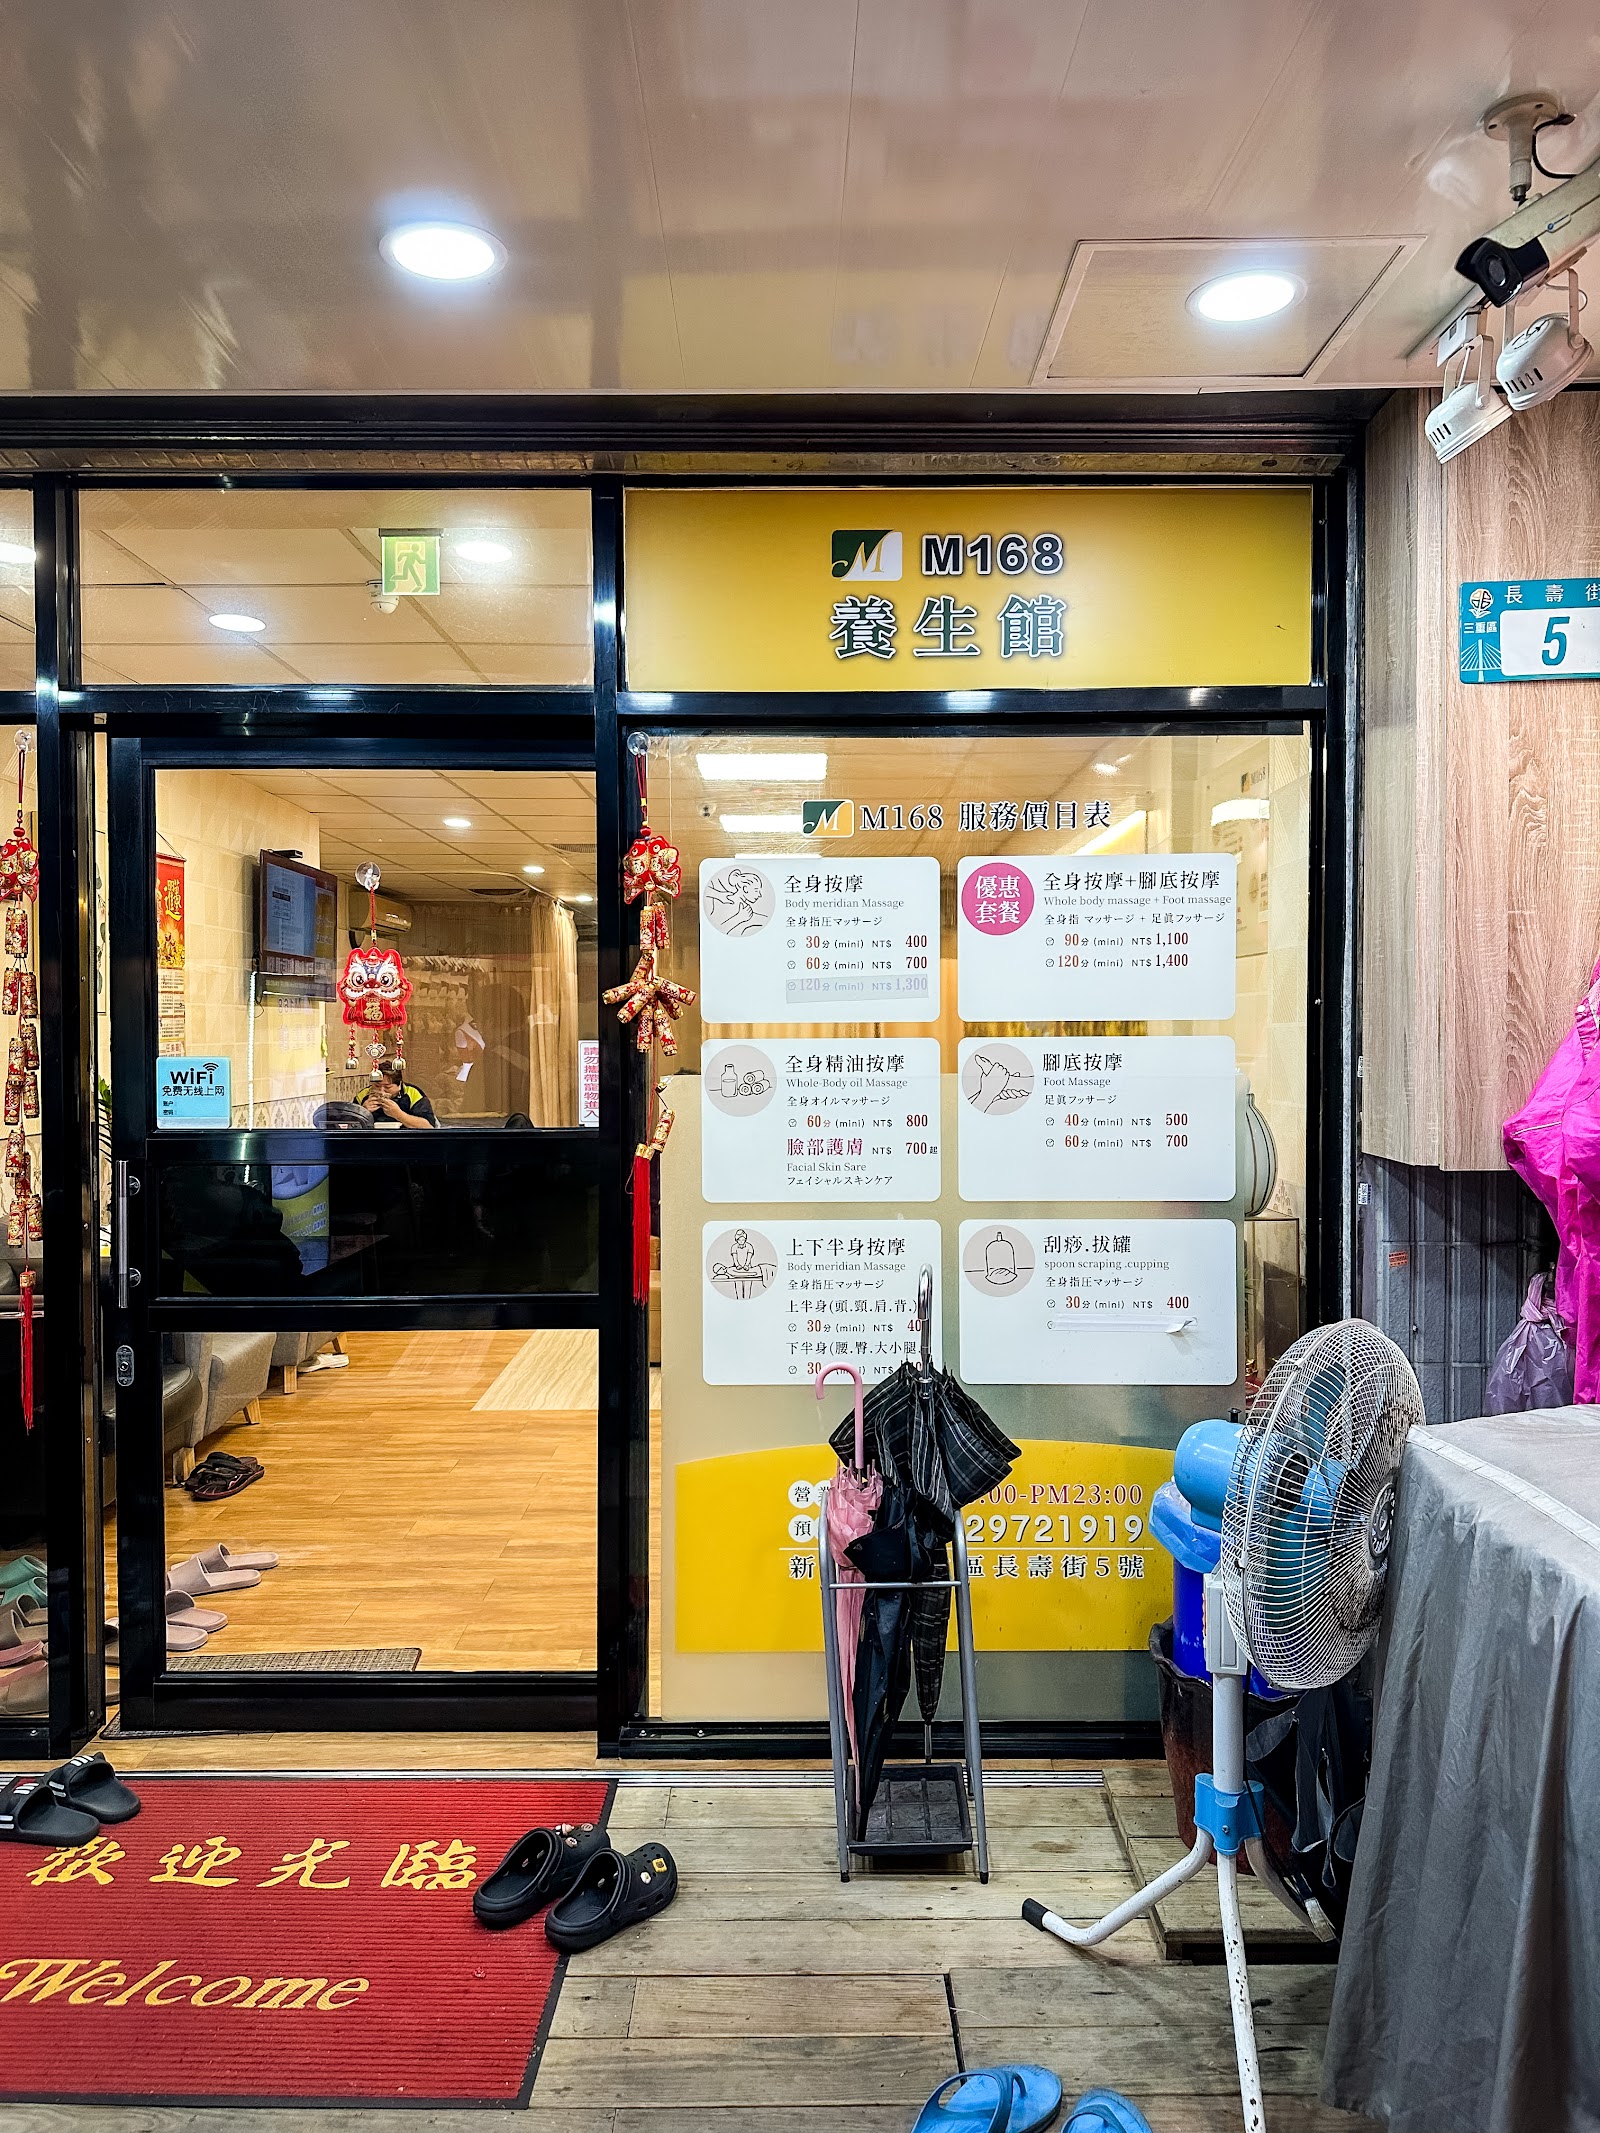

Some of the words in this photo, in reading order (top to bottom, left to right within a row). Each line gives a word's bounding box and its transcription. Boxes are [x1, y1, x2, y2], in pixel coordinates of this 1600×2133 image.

[922, 534, 1063, 575] M168
[1504, 583, 1600, 604] 長壽街
[829, 594, 1066, 659] 養生館
[1463, 621, 1498, 634] 三重區
[1541, 616, 1571, 666] 5
[860, 804, 943, 831] M168
[959, 800, 1112, 832] 服務價目表
[784, 875, 863, 894] 全身按摩
[975, 875, 1021, 899] 優惠
[1043, 870, 1220, 892] 全身按摩+腳底按摩
[785, 899, 810, 910] Body
[813, 899, 858, 908] meridian
[862, 899, 905, 910] Massage
[1044, 895, 1077, 905] Whole
[1080, 895, 1105, 907] body
[1108, 897, 1151, 907] massage
[1162, 895, 1186, 904] Foot
[1188, 896, 1232, 906] massage
[975, 901, 1021, 924] 套餐
[1044, 914, 1079, 925] 全身指
[1084, 914, 1135, 924] マッサージ
[806, 936, 830, 949] 30分
[834, 940, 864, 950] (mini)
[872, 940, 892, 948] NT$
[905, 935, 928, 948] 400
[1064, 934, 1088, 946] 90分
[1094, 937, 1124, 946] (mini)
[1132, 937, 1152, 946] NT$
[1155, 932, 1188, 946] 1,100
[806, 957, 830, 970] 60分
[834, 961, 864, 971] (mini)
[872, 961, 892, 970] NT$
[905, 956, 928, 970] 700
[1058, 954, 1088, 968] 120分
[1094, 958, 1124, 968] (mini)
[1132, 958, 1152, 968] NT$
[1155, 954, 1188, 968] 1,400
[872, 982, 892, 991] NT$
[895, 978, 928, 991] 1,300
[786, 1054, 905, 1073] 全身精油按摩
[1043, 1053, 1123, 1072] 腳底按摩
[170, 1067, 213, 1084] WiFi
[1044, 1077, 1066, 1086] Foot
[1068, 1077, 1111, 1088] Massage
[786, 1078, 848, 1090] Whole-Body
[850, 1078, 863, 1088] oil
[866, 1078, 908, 1089] Massage
[162, 1086, 225, 1097] 免费无线上网
[807, 1114, 831, 1128] 60分
[835, 1119, 865, 1128] (mini)
[872, 1118, 893, 1128] NT$
[906, 1114, 928, 1127] 800
[1064, 1114, 1090, 1127] 40分
[1093, 1118, 1124, 1128] (mini)
[1132, 1117, 1152, 1126] NT$
[1165, 1114, 1188, 1126] 500
[787, 1138, 863, 1156] 臉部護膚
[872, 1146, 892, 1155] NT$
[1064, 1135, 1090, 1148] 60分
[1093, 1138, 1124, 1148] (mini)
[1132, 1138, 1152, 1148] NT$
[1166, 1134, 1188, 1148] 700
[786, 1162, 816, 1172] Facial
[818, 1162, 842, 1172] Skin
[844, 1162, 866, 1172] Sare
[788, 1176, 893, 1186] フェイシャルスキンケア
[786, 1238, 906, 1257] 上下半身按摩
[1043, 1235, 1132, 1254] 刮痧.拔罐
[788, 1262, 812, 1272] Body
[814, 1262, 861, 1271] meridian
[863, 1262, 906, 1272] Massage
[1044, 1260, 1075, 1270] spoon
[1077, 1259, 1122, 1270] scraping
[1066, 1296, 1090, 1308] 30分
[1094, 1300, 1125, 1310] (mini)
[1132, 1300, 1153, 1309] NT$
[1166, 1296, 1190, 1308] 400
[807, 1320, 831, 1332] 30分
[836, 1324, 866, 1332] (mini)
[873, 1324, 894, 1332] NT$
[907, 1320, 922, 1332] 40
[786, 1341, 921, 1356] 下半身(腰.臀.大小腿.
[808, 1362, 821, 1375] 30
[874, 1366, 894, 1375] NT$
[0, 1958, 370, 2011] Welcome
